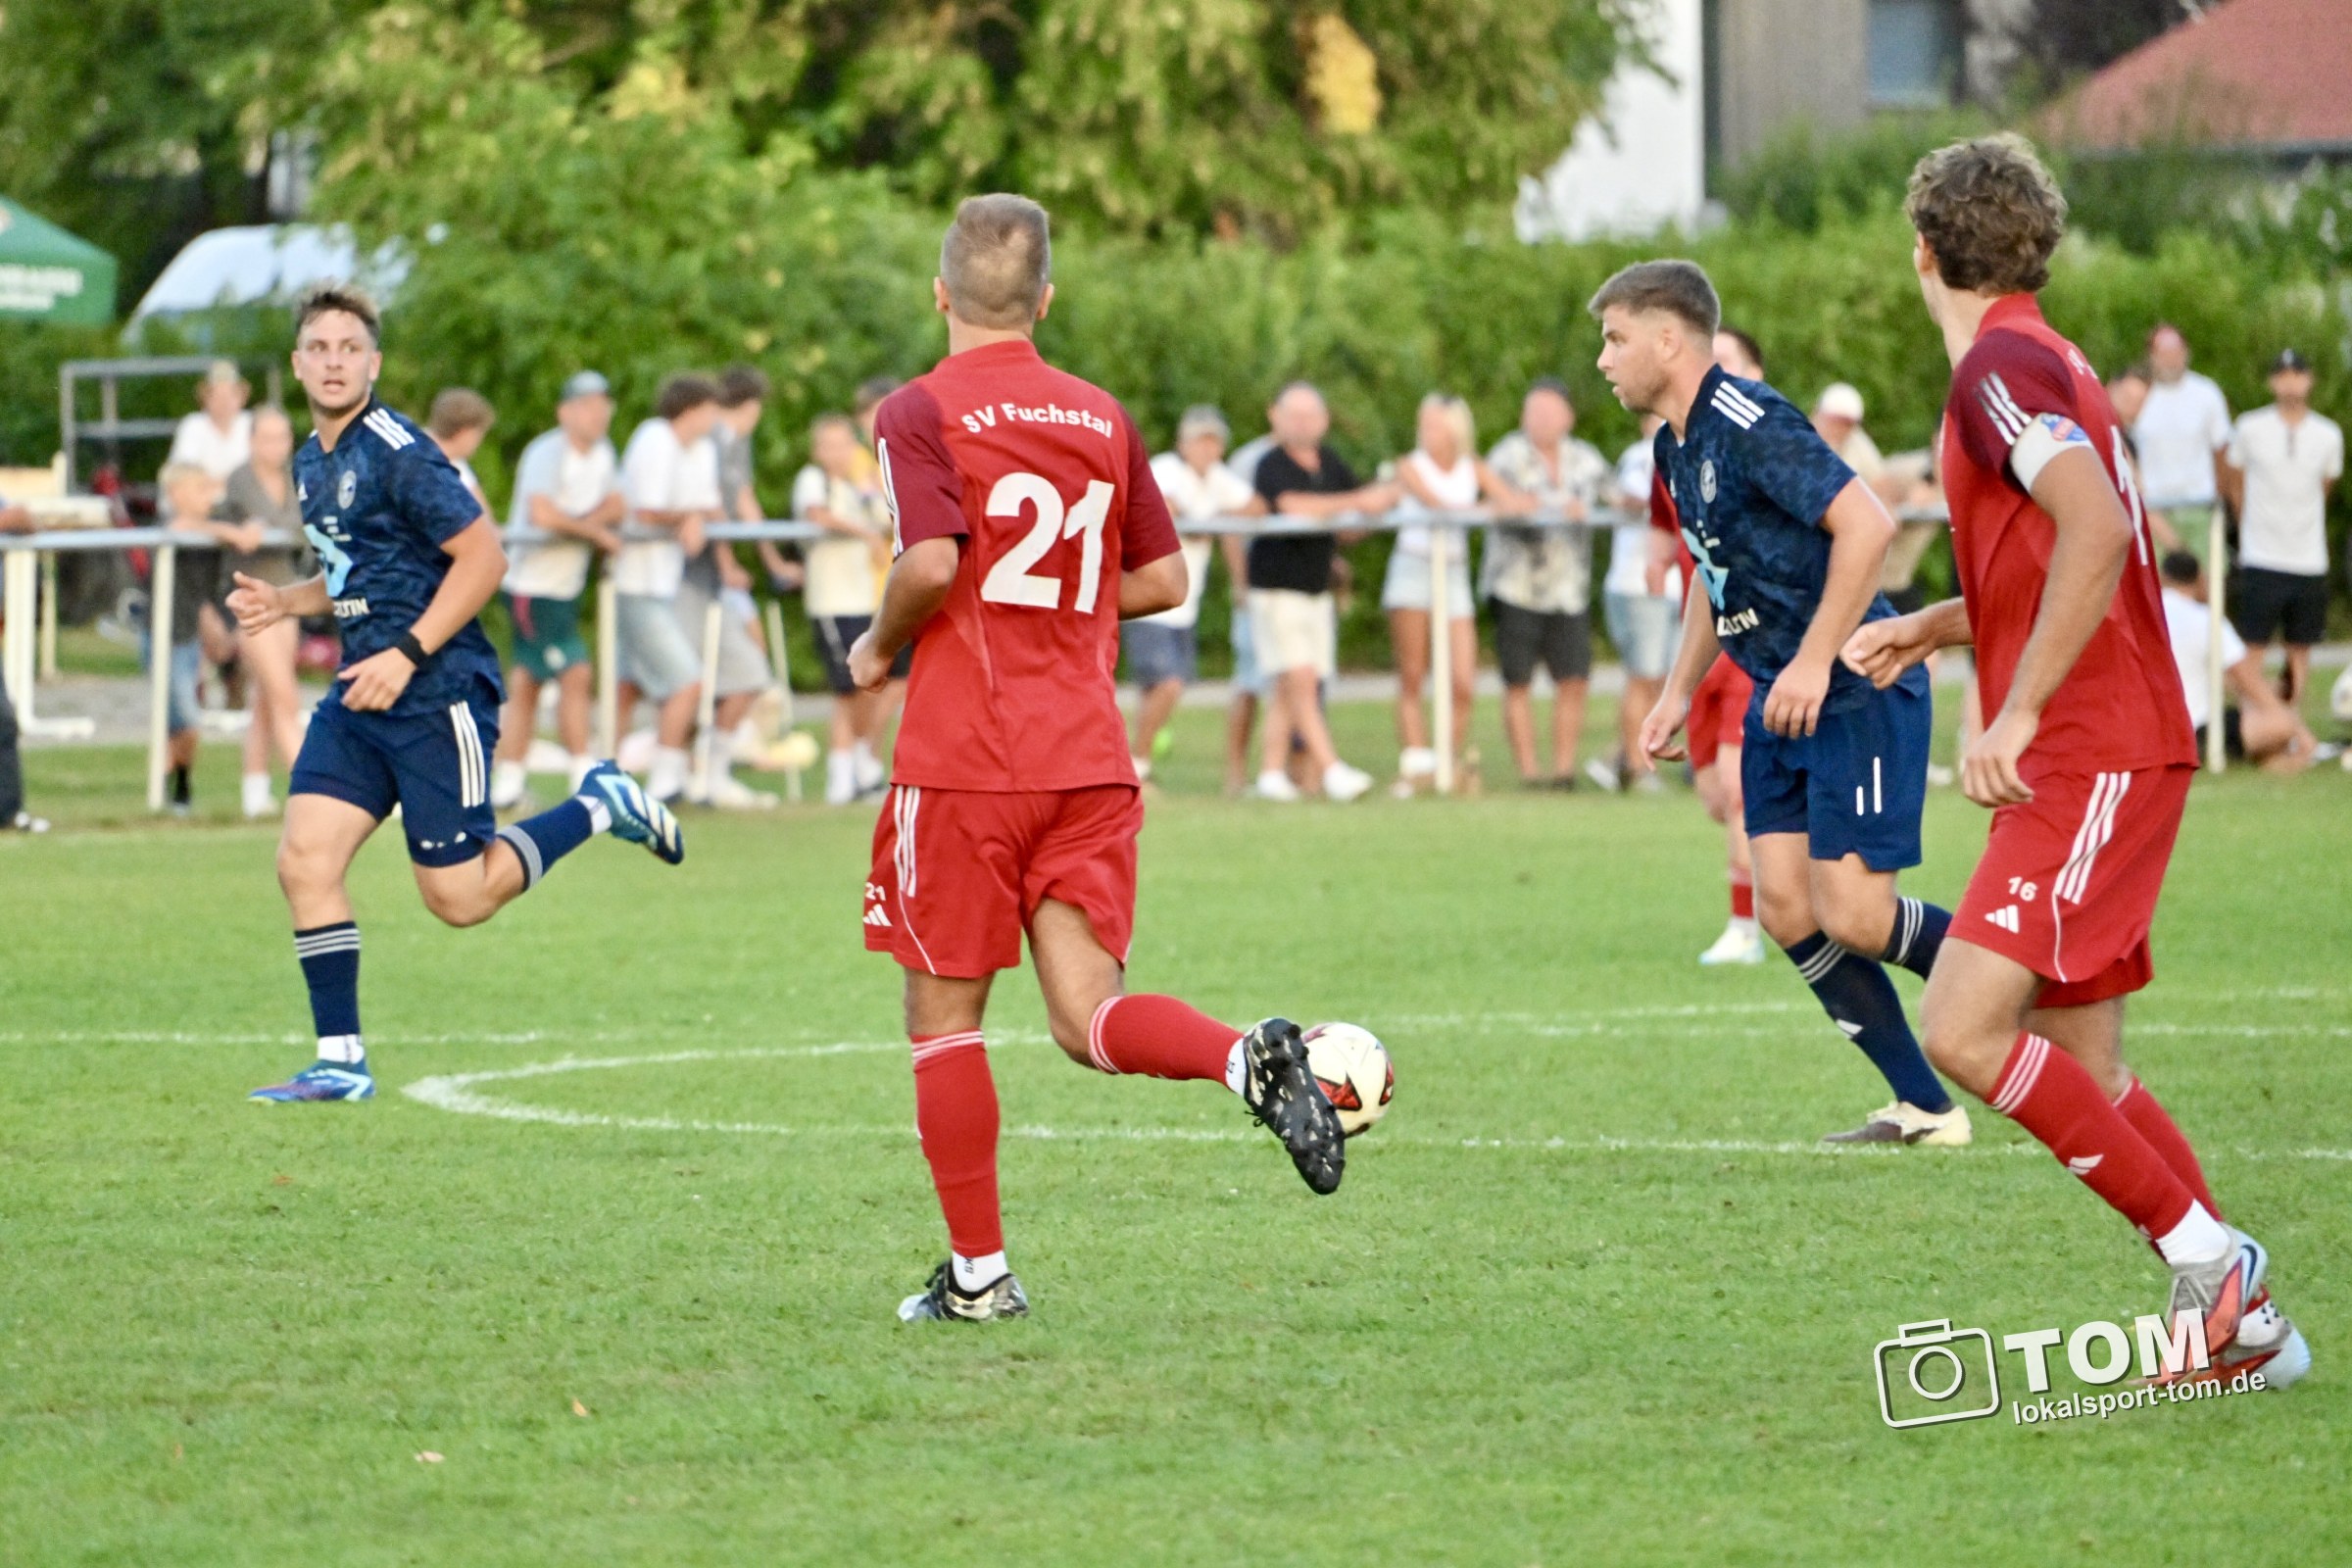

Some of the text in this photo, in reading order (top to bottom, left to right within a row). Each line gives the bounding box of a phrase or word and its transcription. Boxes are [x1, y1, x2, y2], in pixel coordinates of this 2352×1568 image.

[962, 403, 1112, 438] SV Fuchstal
[981, 471, 1115, 614] 21
[864, 881, 886, 901] 21
[2008, 876, 2038, 902] 16
